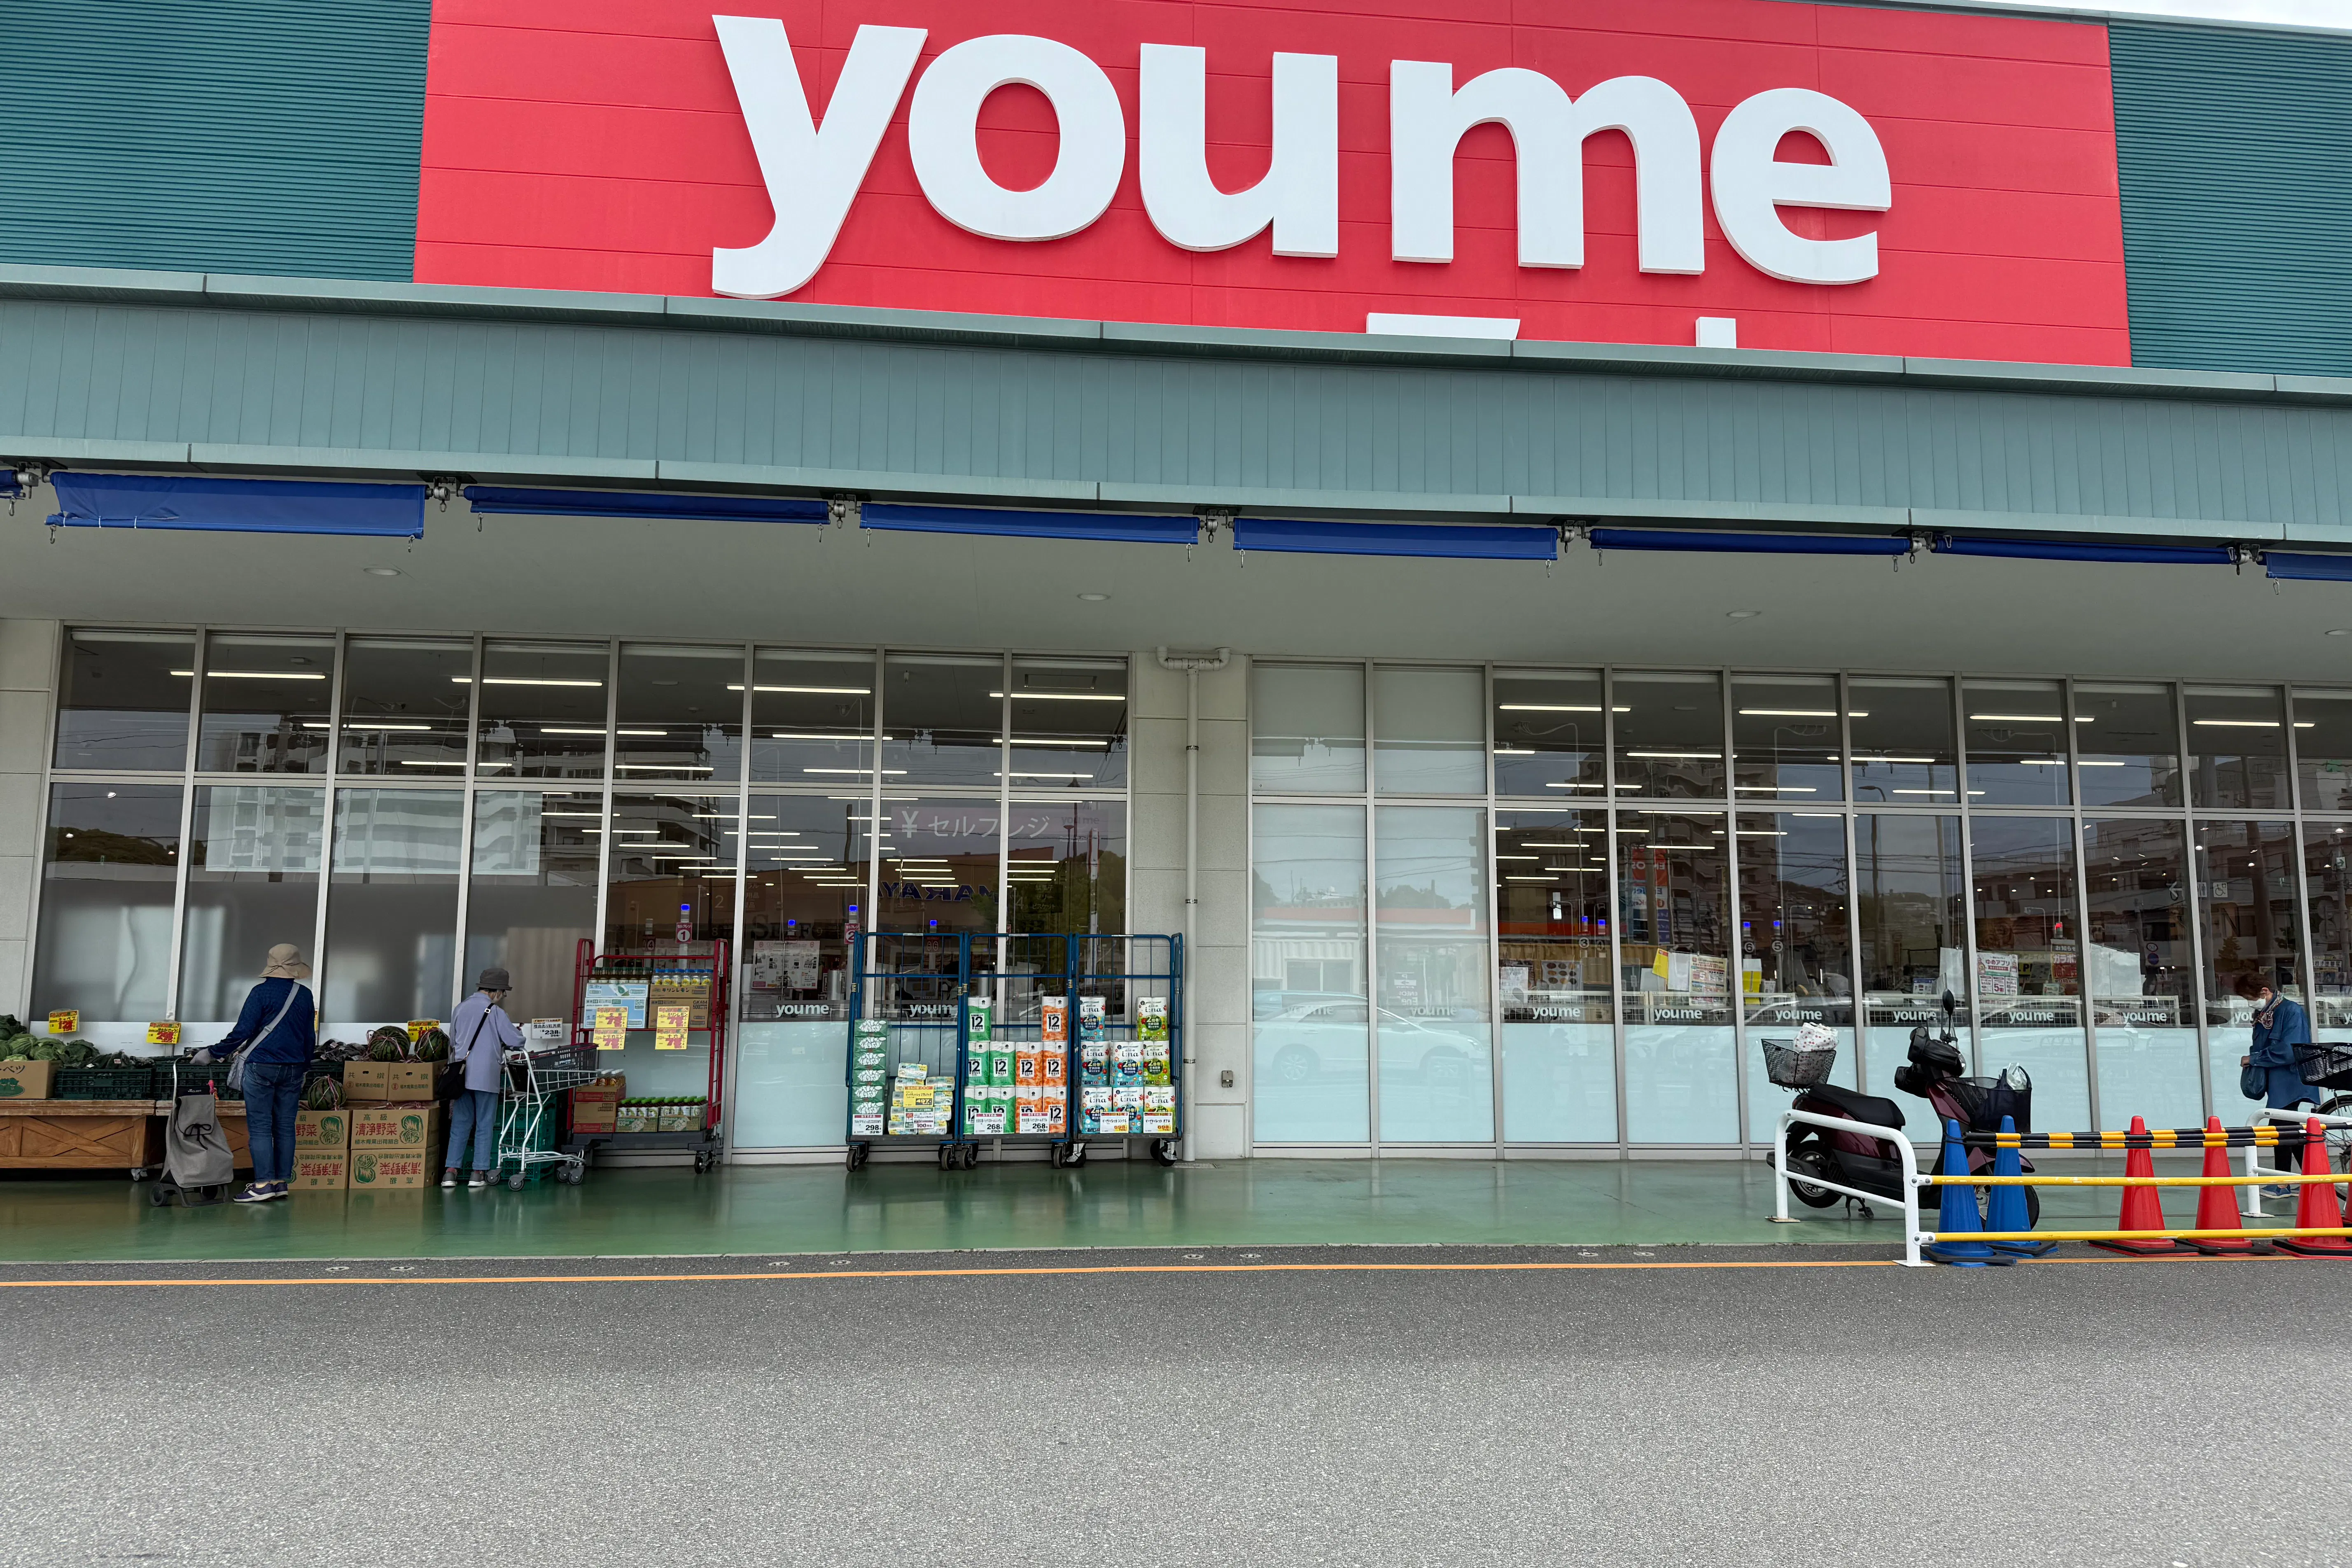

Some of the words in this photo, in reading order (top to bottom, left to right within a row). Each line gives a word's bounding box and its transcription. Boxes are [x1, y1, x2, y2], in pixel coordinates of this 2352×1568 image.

[712, 15, 1891, 300] youme
[681, 931, 686, 940] 1
[1580, 938, 1588, 947] 3
[1746, 943, 1753, 951] 6
[1774, 942, 1782, 950] 5
[2053, 953, 2077, 964] ガラポ
[776, 1004, 830, 1018] youme
[1532, 1006, 1581, 1019] youme
[1654, 1007, 1703, 1021] youme
[1775, 1009, 1822, 1022] youme
[1893, 1009, 1937, 1022] youme
[971, 1016, 983, 1027] 12
[1048, 1016, 1060, 1027] 12
[2009, 1010, 2054, 1024] youme
[2123, 1010, 2167, 1024] youme
[0, 1065, 26, 1074] ベツ
[995, 1061, 1006, 1071] 12
[1021, 1061, 1033, 1072] 12
[1048, 1061, 1059, 1071] 12
[1050, 1107, 1062, 1118] 12
[296, 1124, 317, 1136] 野菜
[355, 1122, 397, 1136] 清浄野菜
